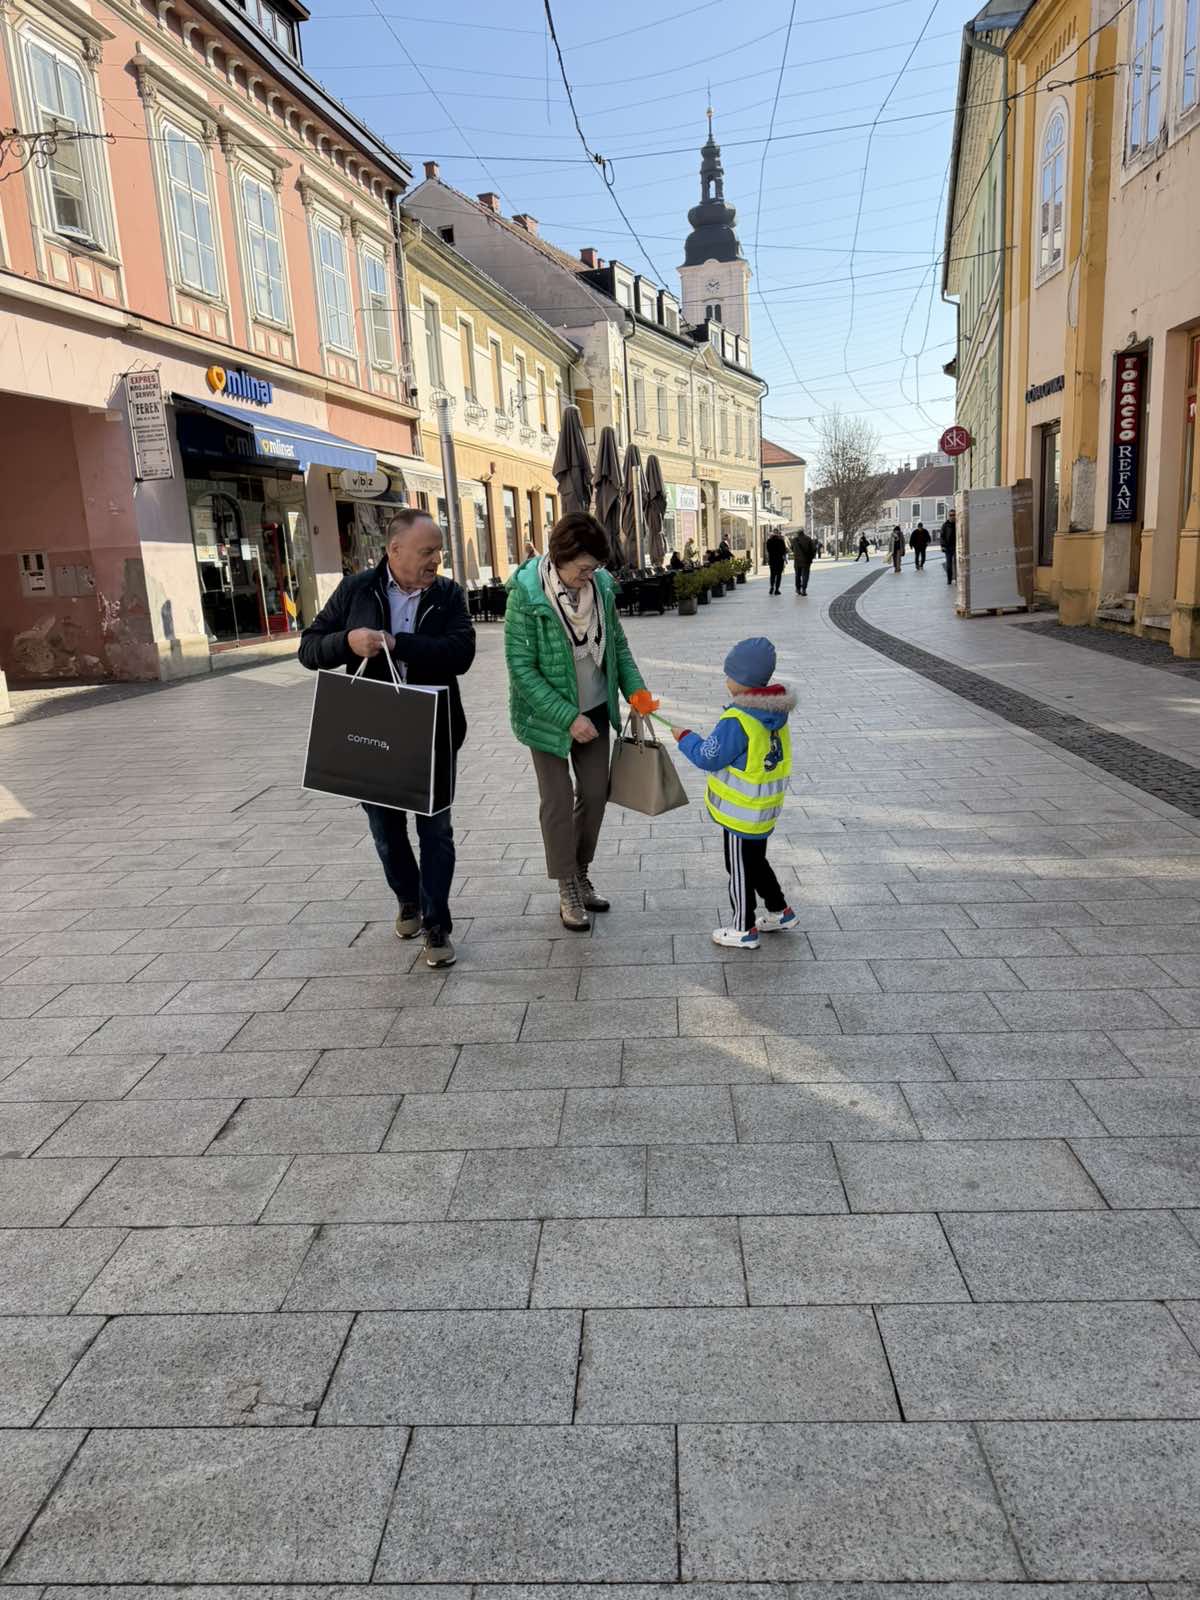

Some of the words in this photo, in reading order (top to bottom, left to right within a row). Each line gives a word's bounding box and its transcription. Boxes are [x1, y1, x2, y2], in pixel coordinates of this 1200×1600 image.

[226, 369, 273, 405] mlinar
[1119, 358, 1138, 441] TOBACCO
[269, 440, 295, 457] mlinar
[1117, 445, 1133, 510] REFAN
